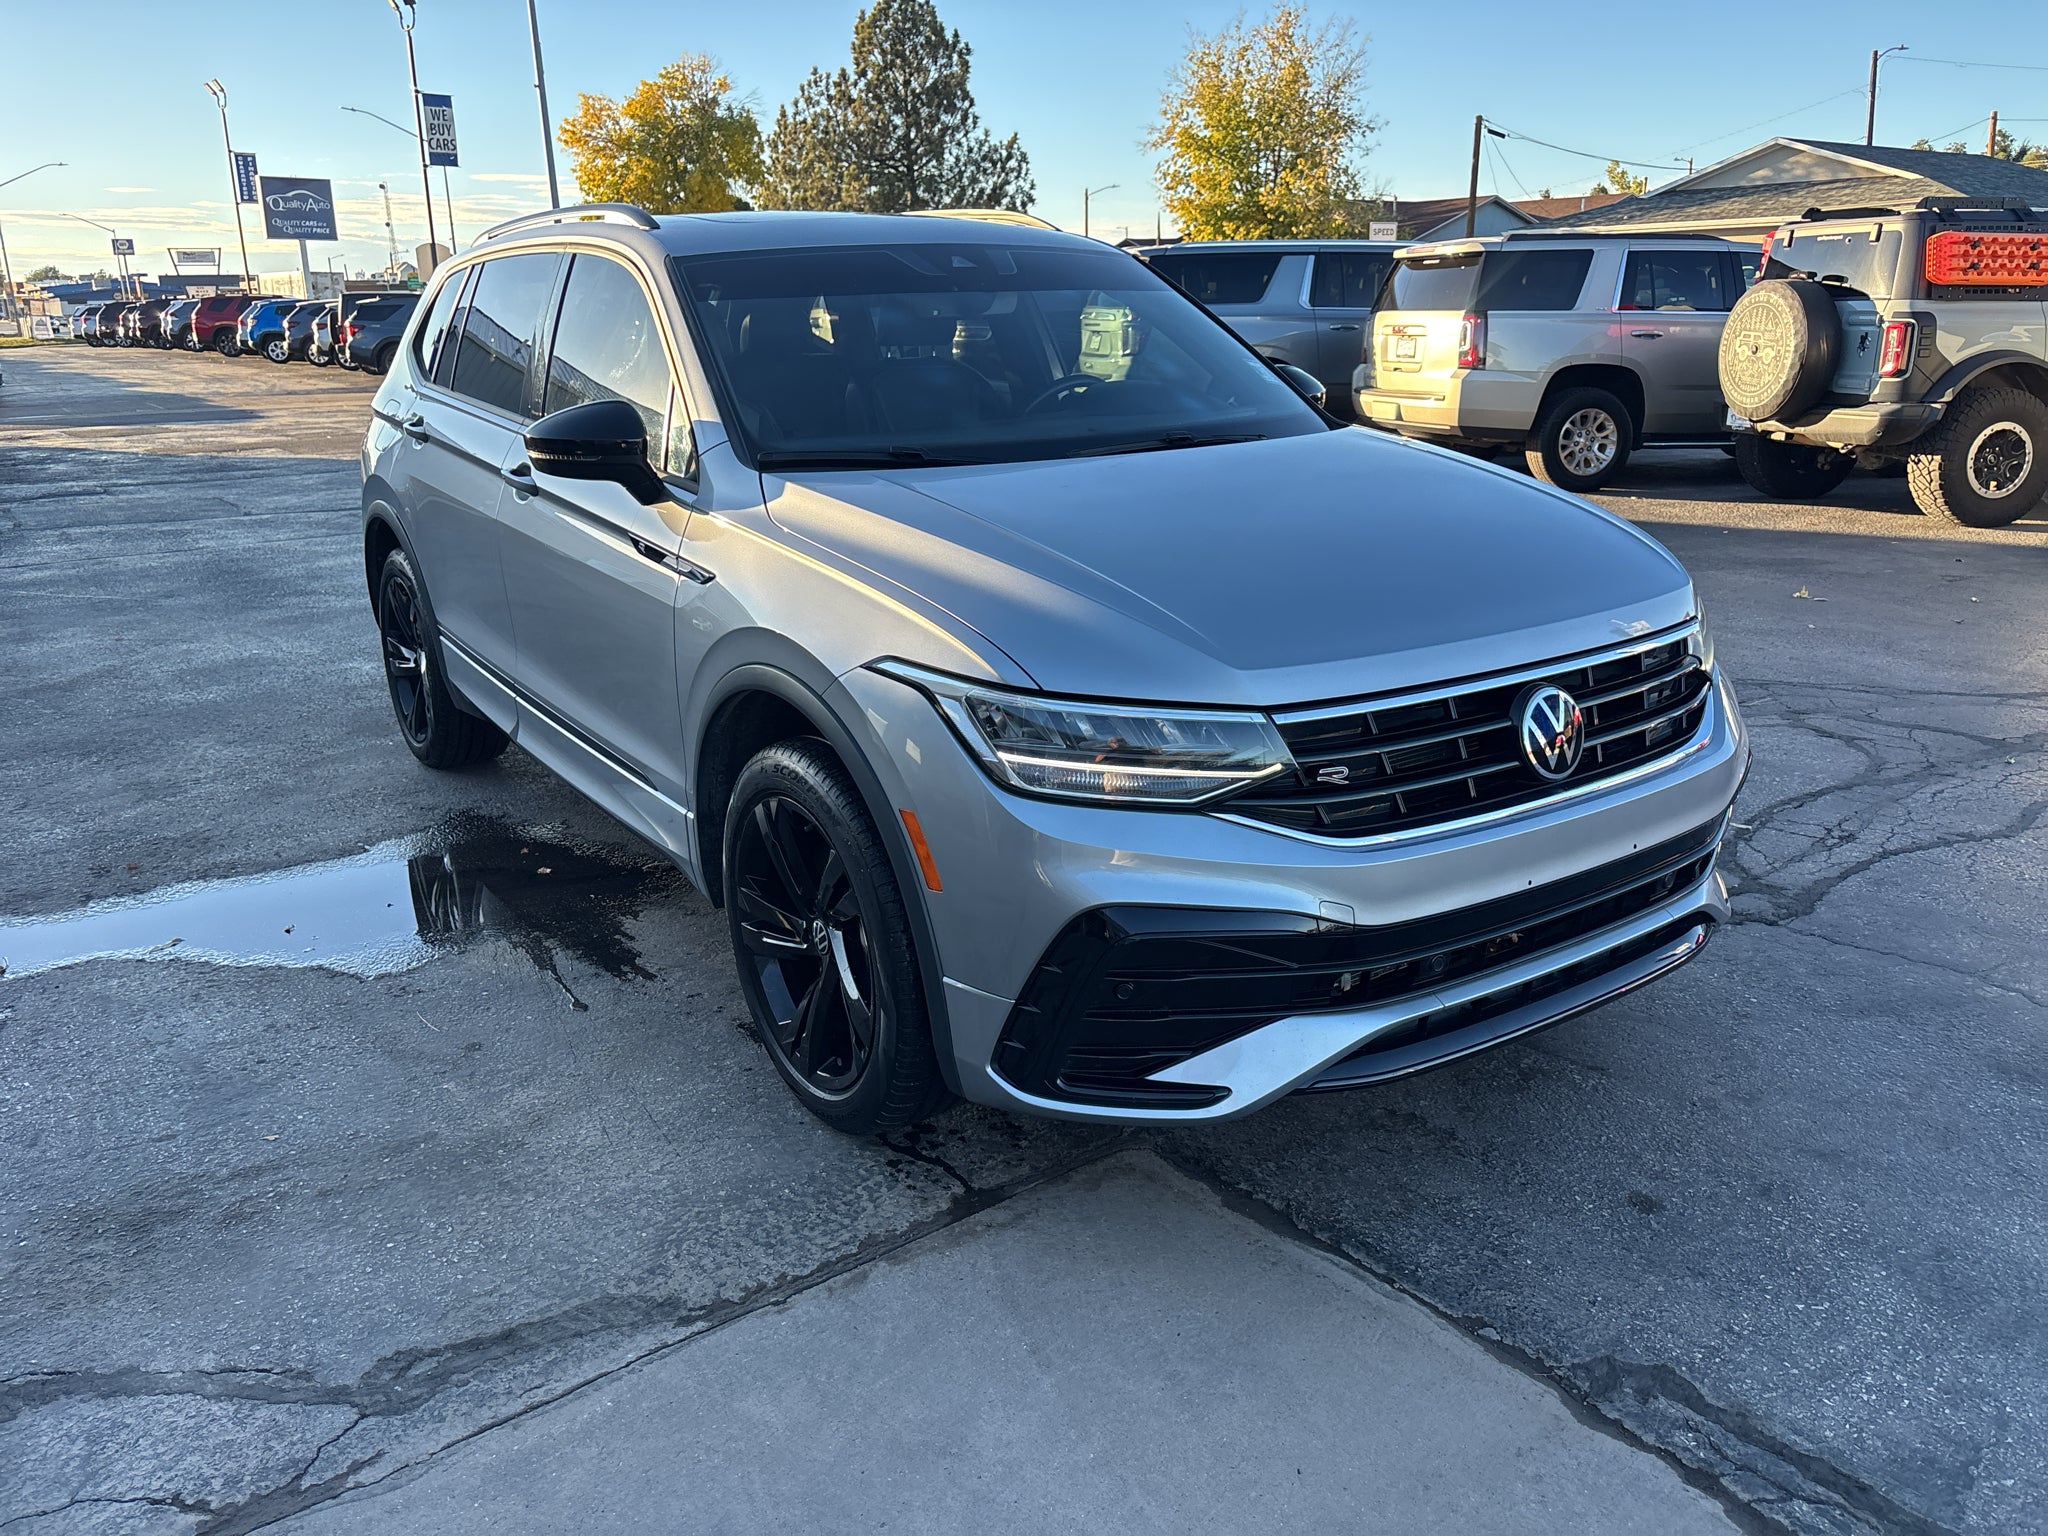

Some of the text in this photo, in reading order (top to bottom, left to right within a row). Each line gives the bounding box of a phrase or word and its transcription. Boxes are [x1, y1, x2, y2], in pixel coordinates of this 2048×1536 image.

[429, 108, 448, 122] WE
[429, 122, 451, 137] BUY
[428, 137, 457, 152] CARS
[271, 217, 301, 227] QUALITY
[283, 225, 311, 234] QUALITY
[1373, 228, 1394, 236] SPEED
